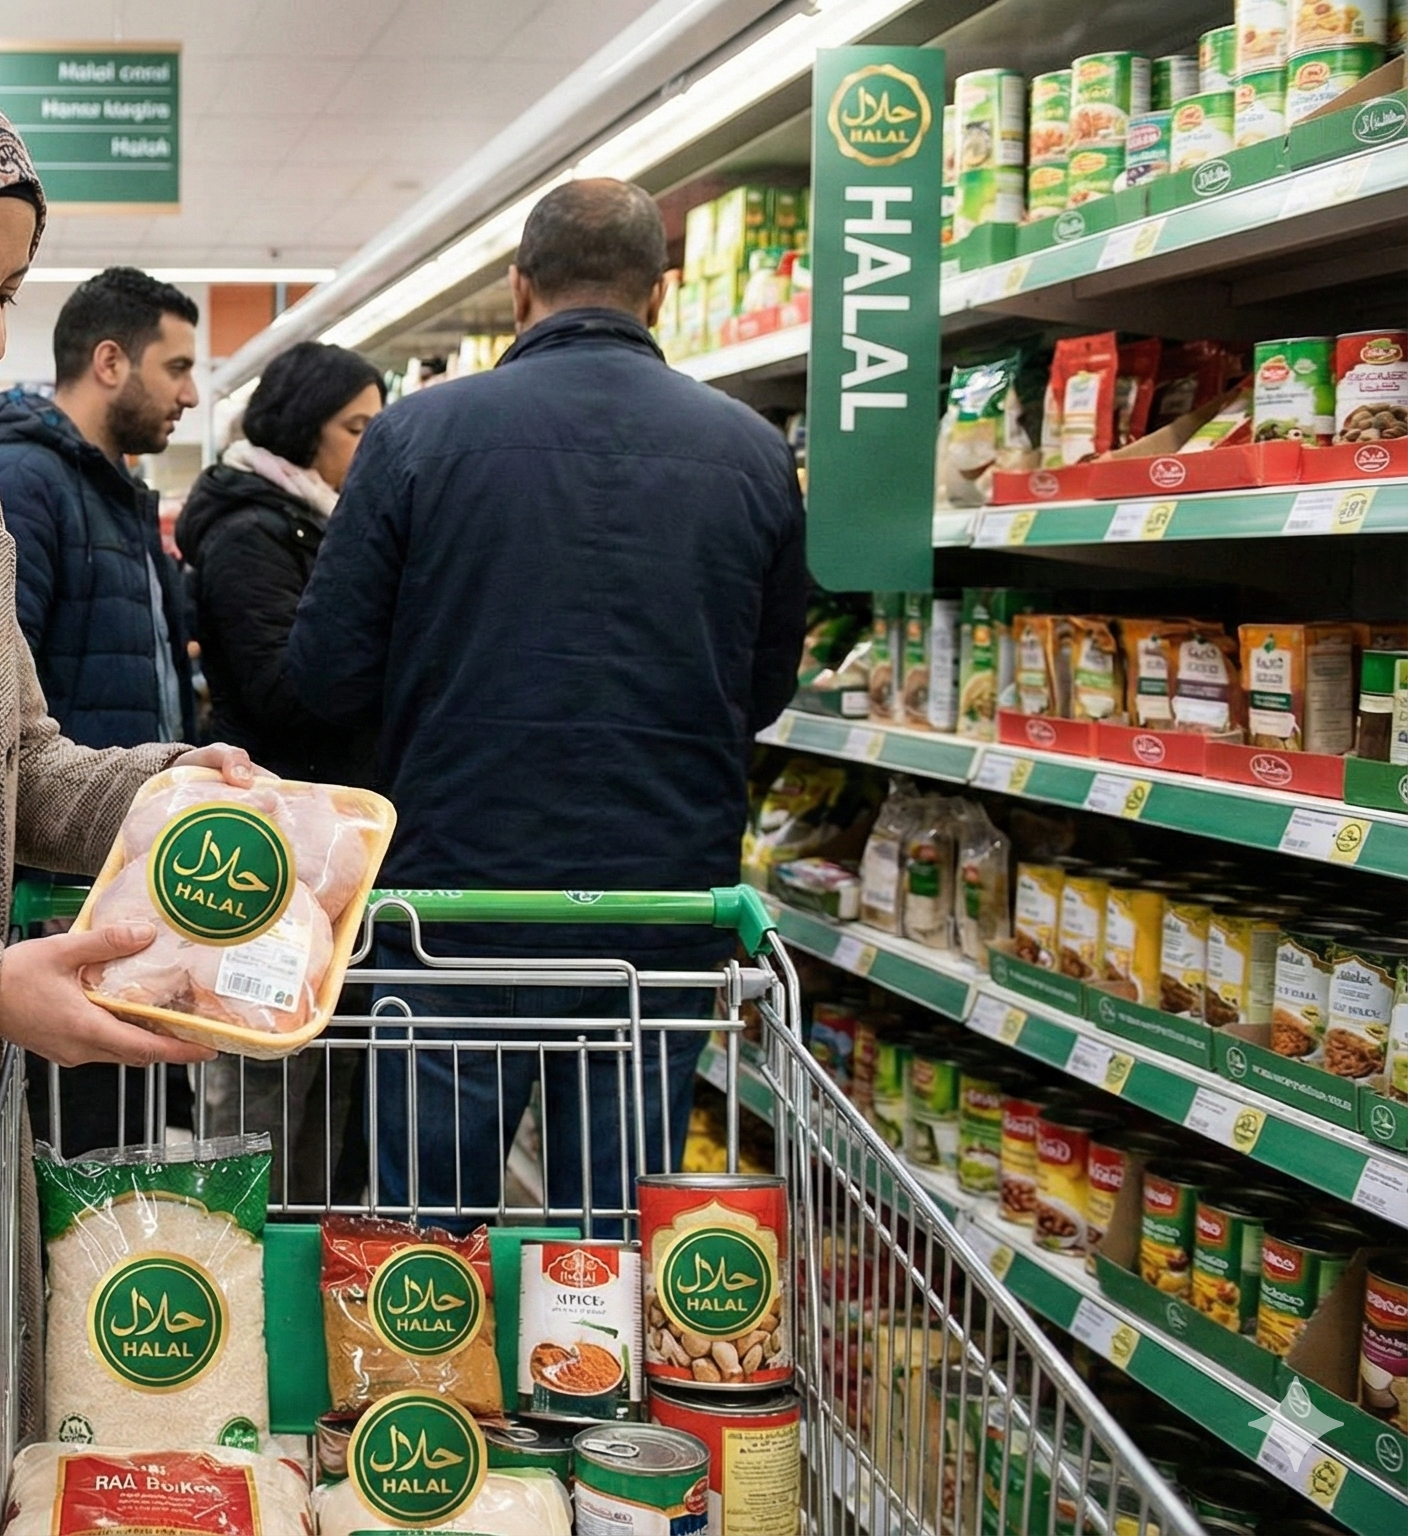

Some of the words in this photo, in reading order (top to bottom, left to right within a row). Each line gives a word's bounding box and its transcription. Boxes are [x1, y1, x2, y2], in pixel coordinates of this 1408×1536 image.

[841, 86, 917, 126] حلال
[850, 129, 910, 143] HALAL
[840, 186, 913, 432] HALAL
[172, 829, 271, 892] حلال
[174, 882, 248, 919] HALAL
[676, 1252, 759, 1294] حلال
[110, 1286, 207, 1337] حلال
[386, 1274, 467, 1315] حلال
[686, 1297, 748, 1312] HALAL
[396, 1318, 457, 1332] HALAL
[122, 1341, 195, 1357] HALAL
[369, 1424, 466, 1473] حلال
[382, 1478, 454, 1494] HALAL
